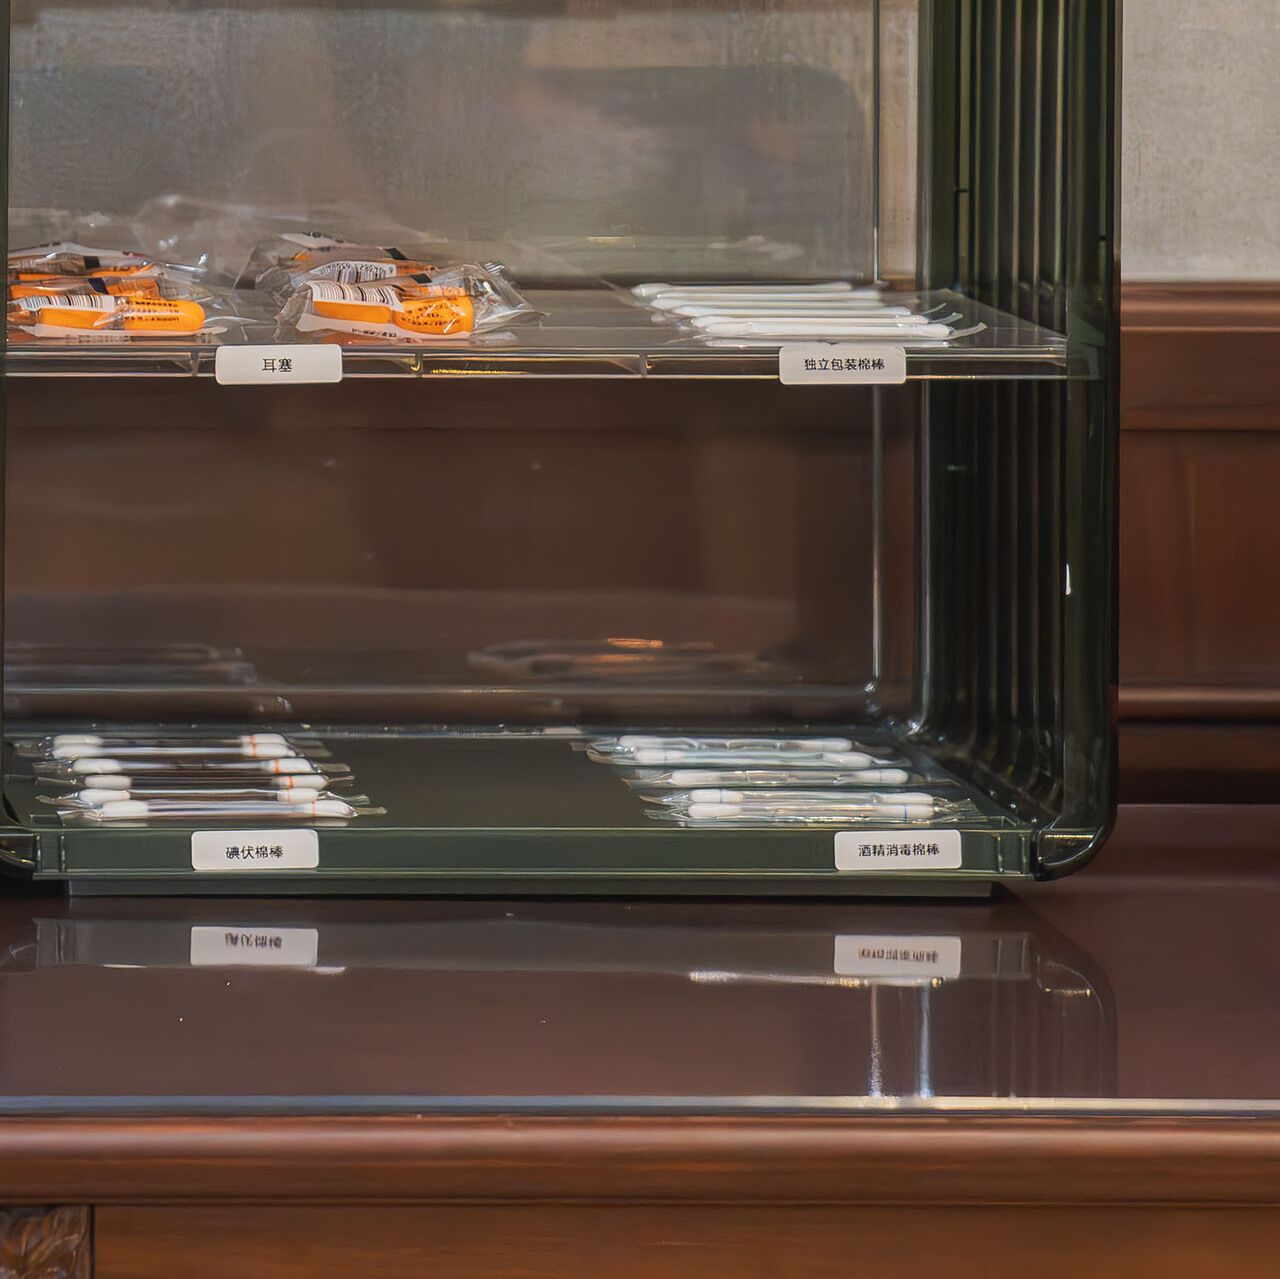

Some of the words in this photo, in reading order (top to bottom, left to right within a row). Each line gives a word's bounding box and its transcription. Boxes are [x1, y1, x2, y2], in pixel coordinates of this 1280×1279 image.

[261, 357, 293, 373] 耳塞
[804, 357, 886, 371] 独立包装棉棒
[225, 845, 284, 860] 碘伏棉棒
[858, 842, 940, 857] 酒精消毒棉棒
